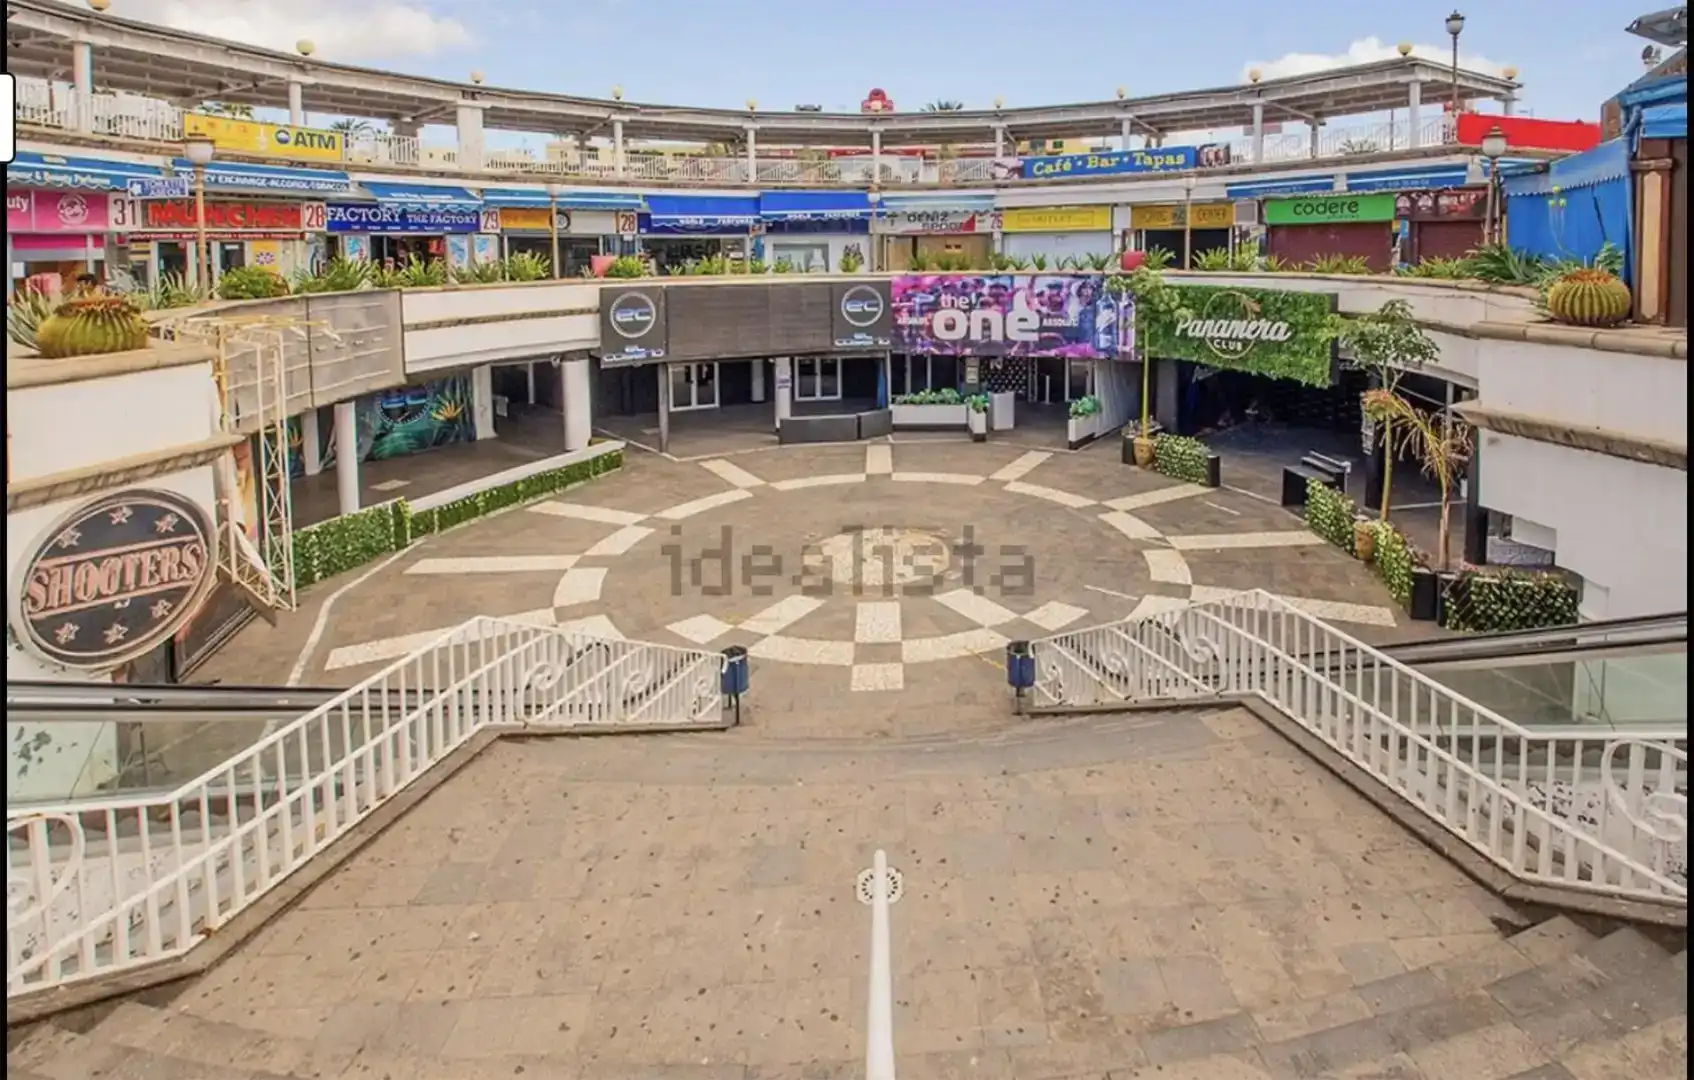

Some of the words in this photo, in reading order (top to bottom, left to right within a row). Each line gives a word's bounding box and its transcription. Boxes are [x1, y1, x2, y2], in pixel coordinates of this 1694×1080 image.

[294, 131, 336, 150] ATM
[1032, 159, 1072, 176] Café
[1087, 155, 1120, 169] Bar
[1132, 151, 1185, 168] Tapas
[113, 197, 136, 226] 31
[306, 203, 326, 228] 28
[326, 205, 400, 223] FACTORY
[1293, 199, 1360, 216] codere
[407, 213, 429, 224] THE
[430, 213, 478, 225] FACTORY
[483, 209, 499, 230] 29
[620, 213, 636, 232] 28
[932, 289, 1040, 342] one
[1175, 316, 1294, 342] Panamera
[1213, 339, 1243, 351] CLUB
[27, 543, 203, 613] SHOOTERS
